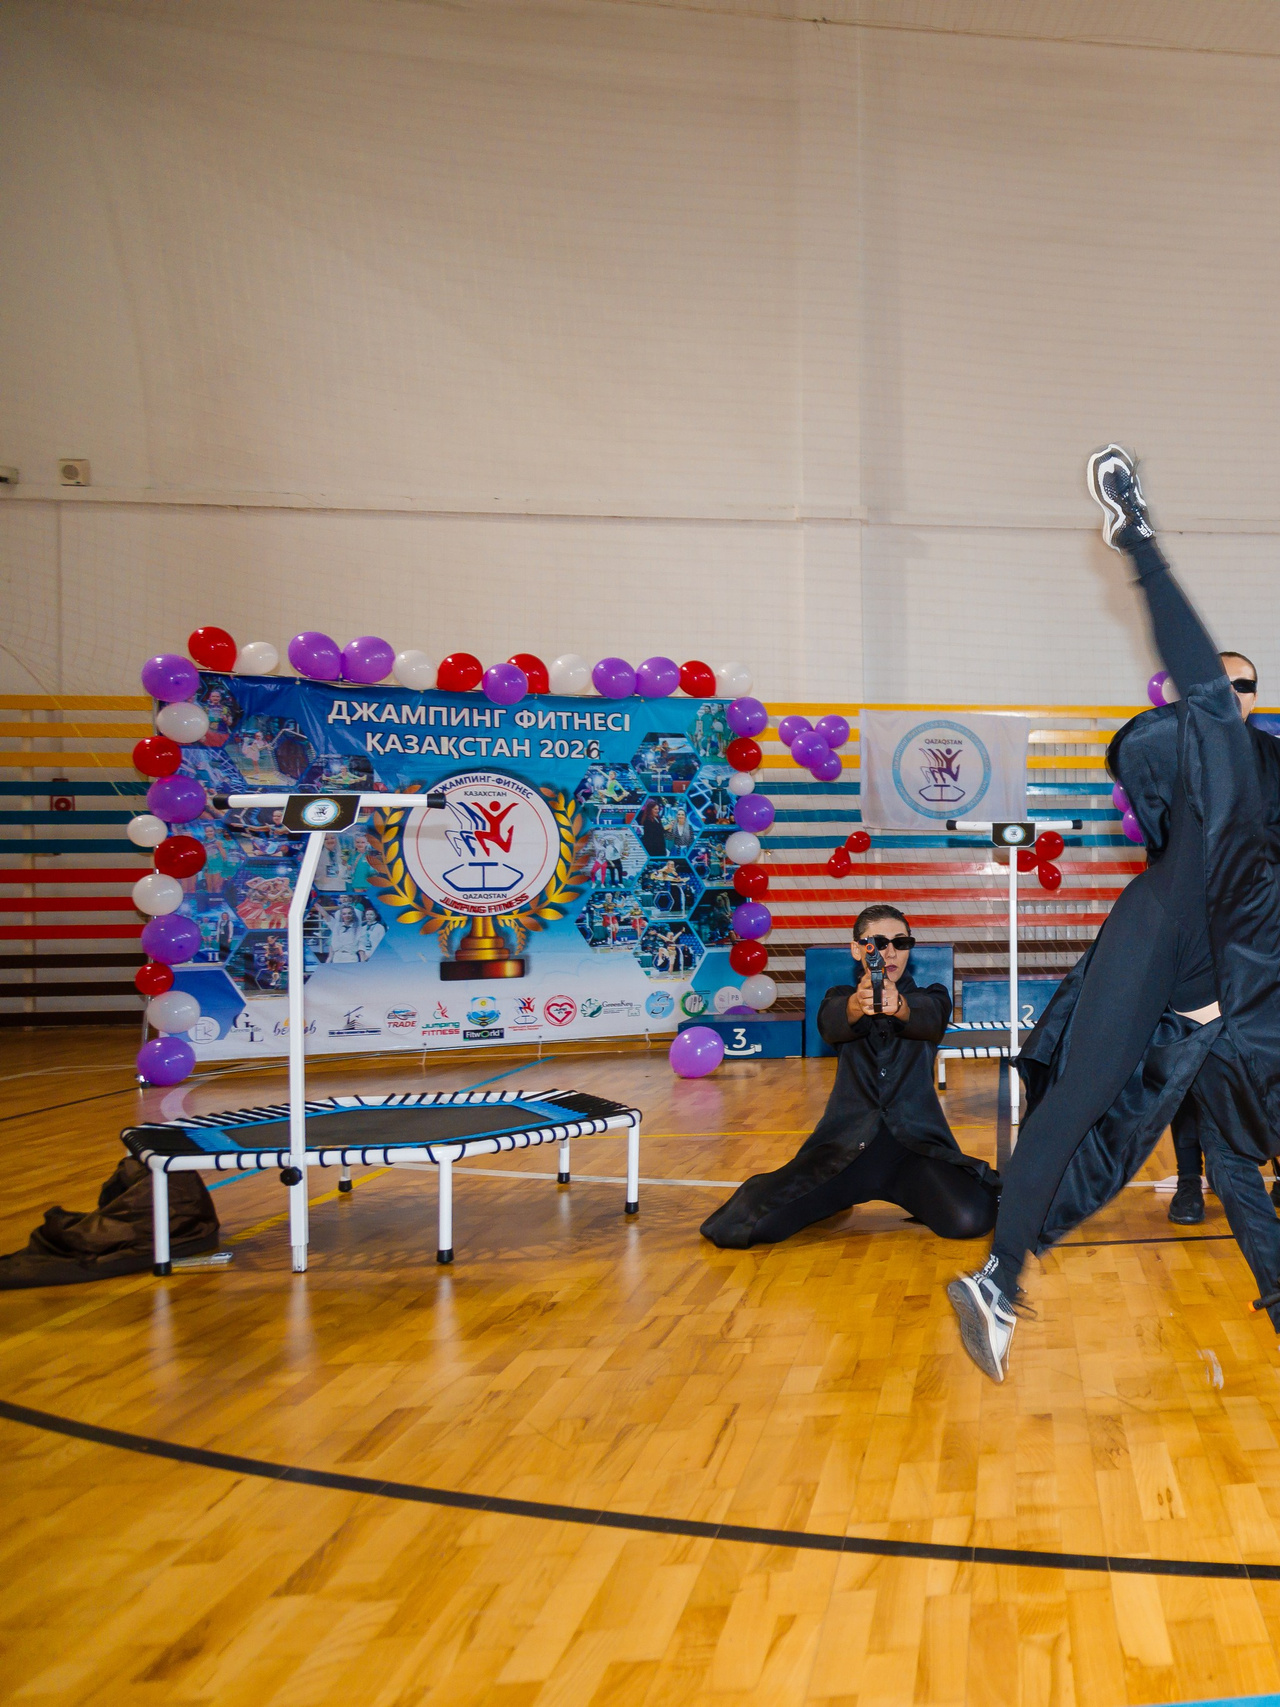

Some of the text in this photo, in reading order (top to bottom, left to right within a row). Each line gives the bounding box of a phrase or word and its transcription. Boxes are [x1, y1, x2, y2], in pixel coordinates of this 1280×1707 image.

[328, 700, 631, 732] ДЖАМПИНГ ФИТНЕСІ
[366, 732, 602, 760] ҚАЗАҚСТАН 2026
[439, 892, 530, 914] JUMPING FITNESS
[1022, 1004, 1035, 1022] 2
[387, 1020, 417, 1029] TRADE
[733, 1028, 747, 1049] 3
